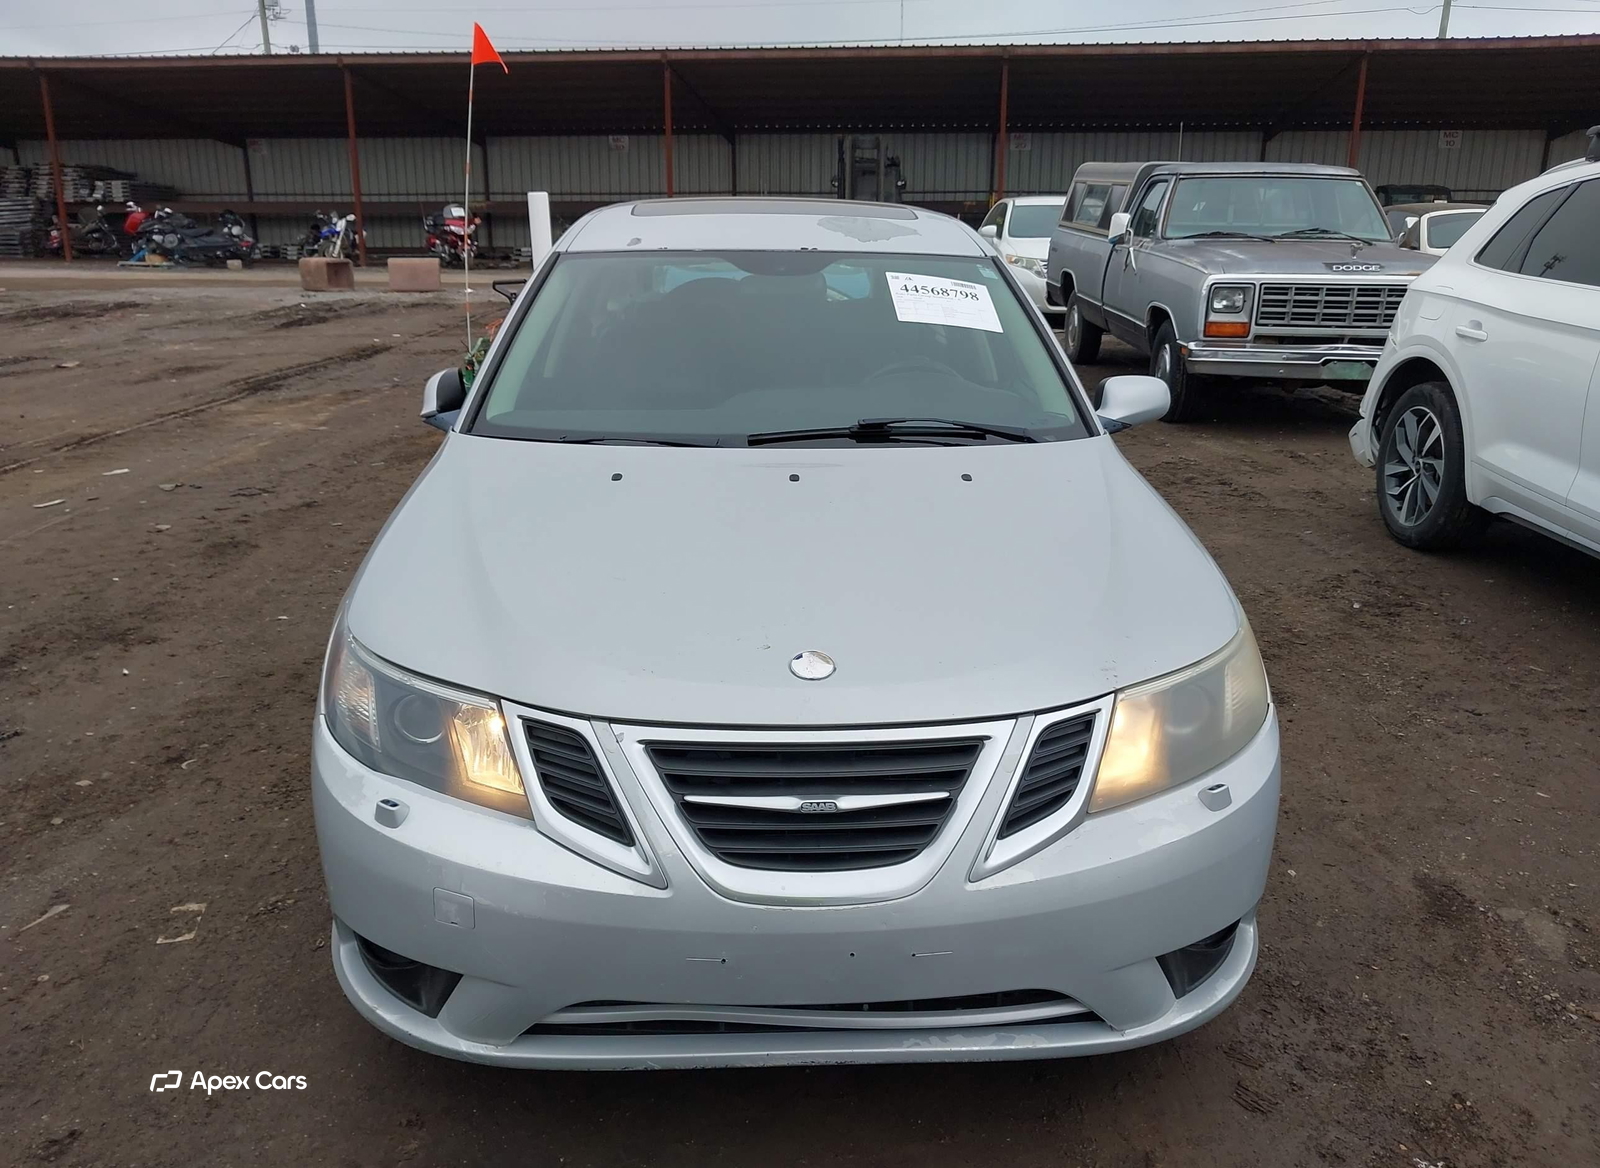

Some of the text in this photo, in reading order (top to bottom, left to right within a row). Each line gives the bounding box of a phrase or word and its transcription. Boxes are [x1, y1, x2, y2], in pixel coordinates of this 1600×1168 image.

[1443, 131, 1459, 139] MC
[899, 283, 980, 302] 44568798
[801, 802, 836, 811] SAAB
